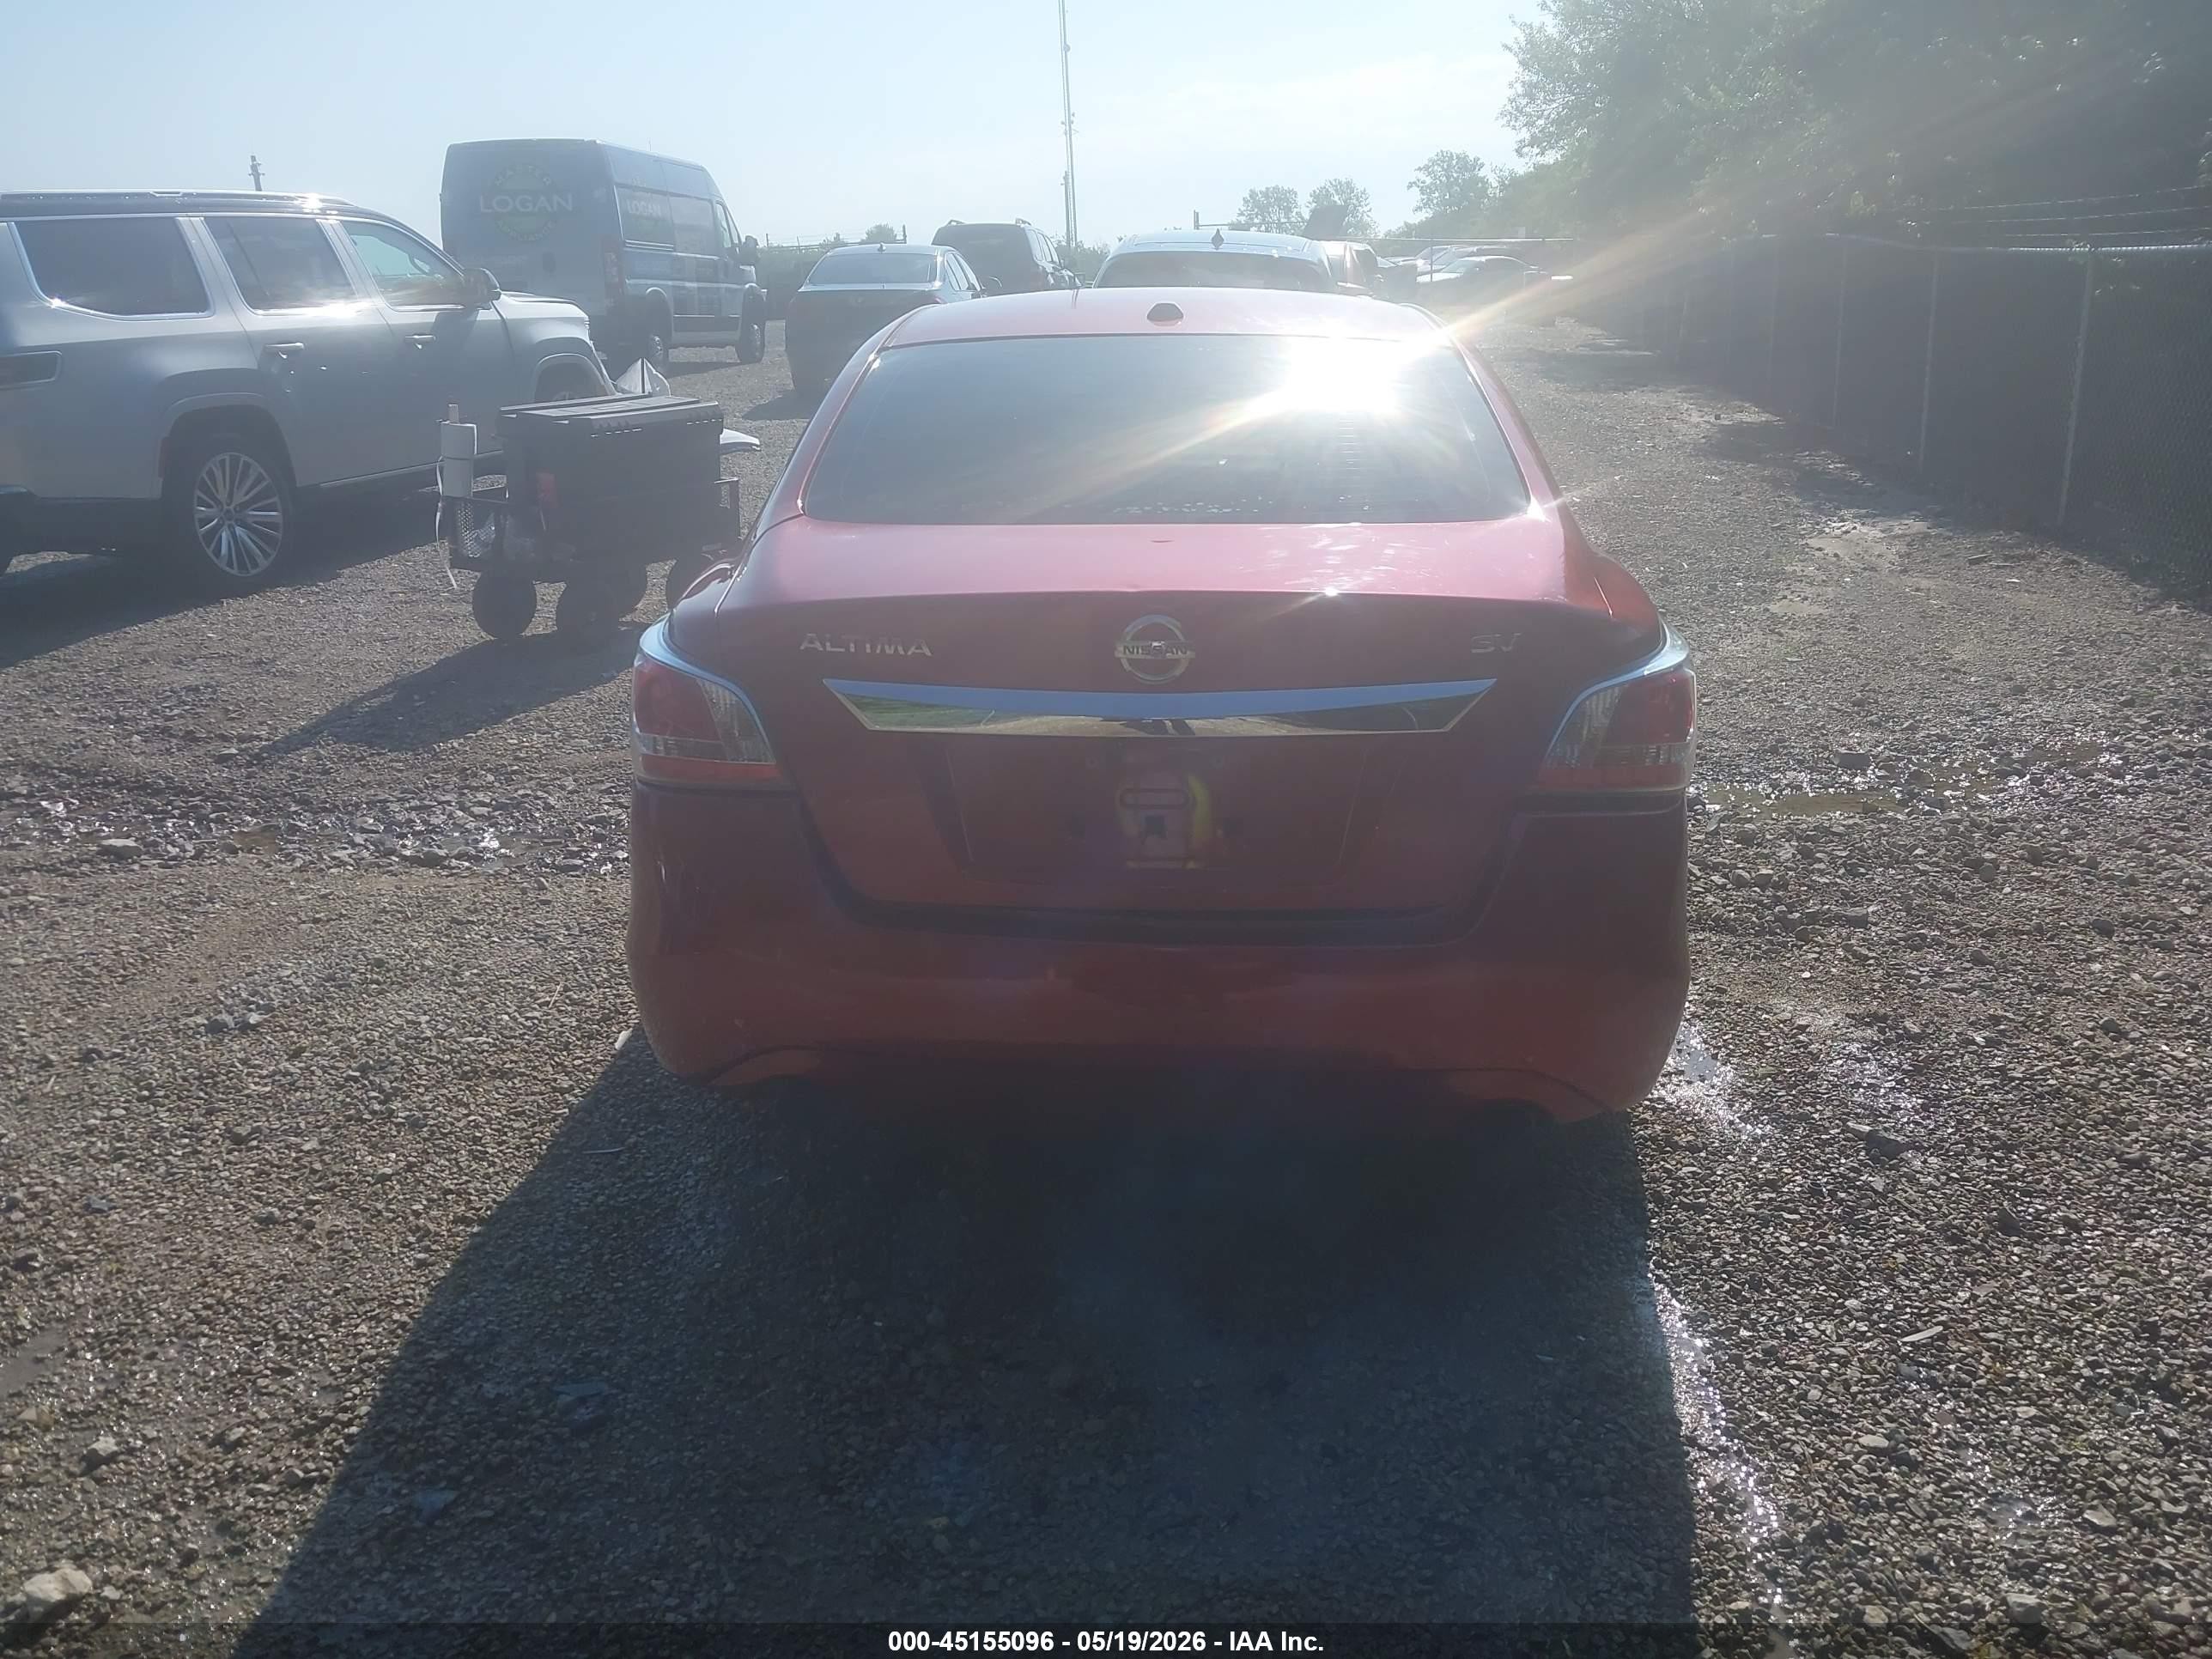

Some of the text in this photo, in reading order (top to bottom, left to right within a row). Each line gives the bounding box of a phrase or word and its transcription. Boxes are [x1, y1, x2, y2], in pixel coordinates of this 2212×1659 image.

[479, 194, 573, 213] LOGAN
[799, 633, 933, 656] ALTIMA
[1470, 632, 1523, 653] SV
